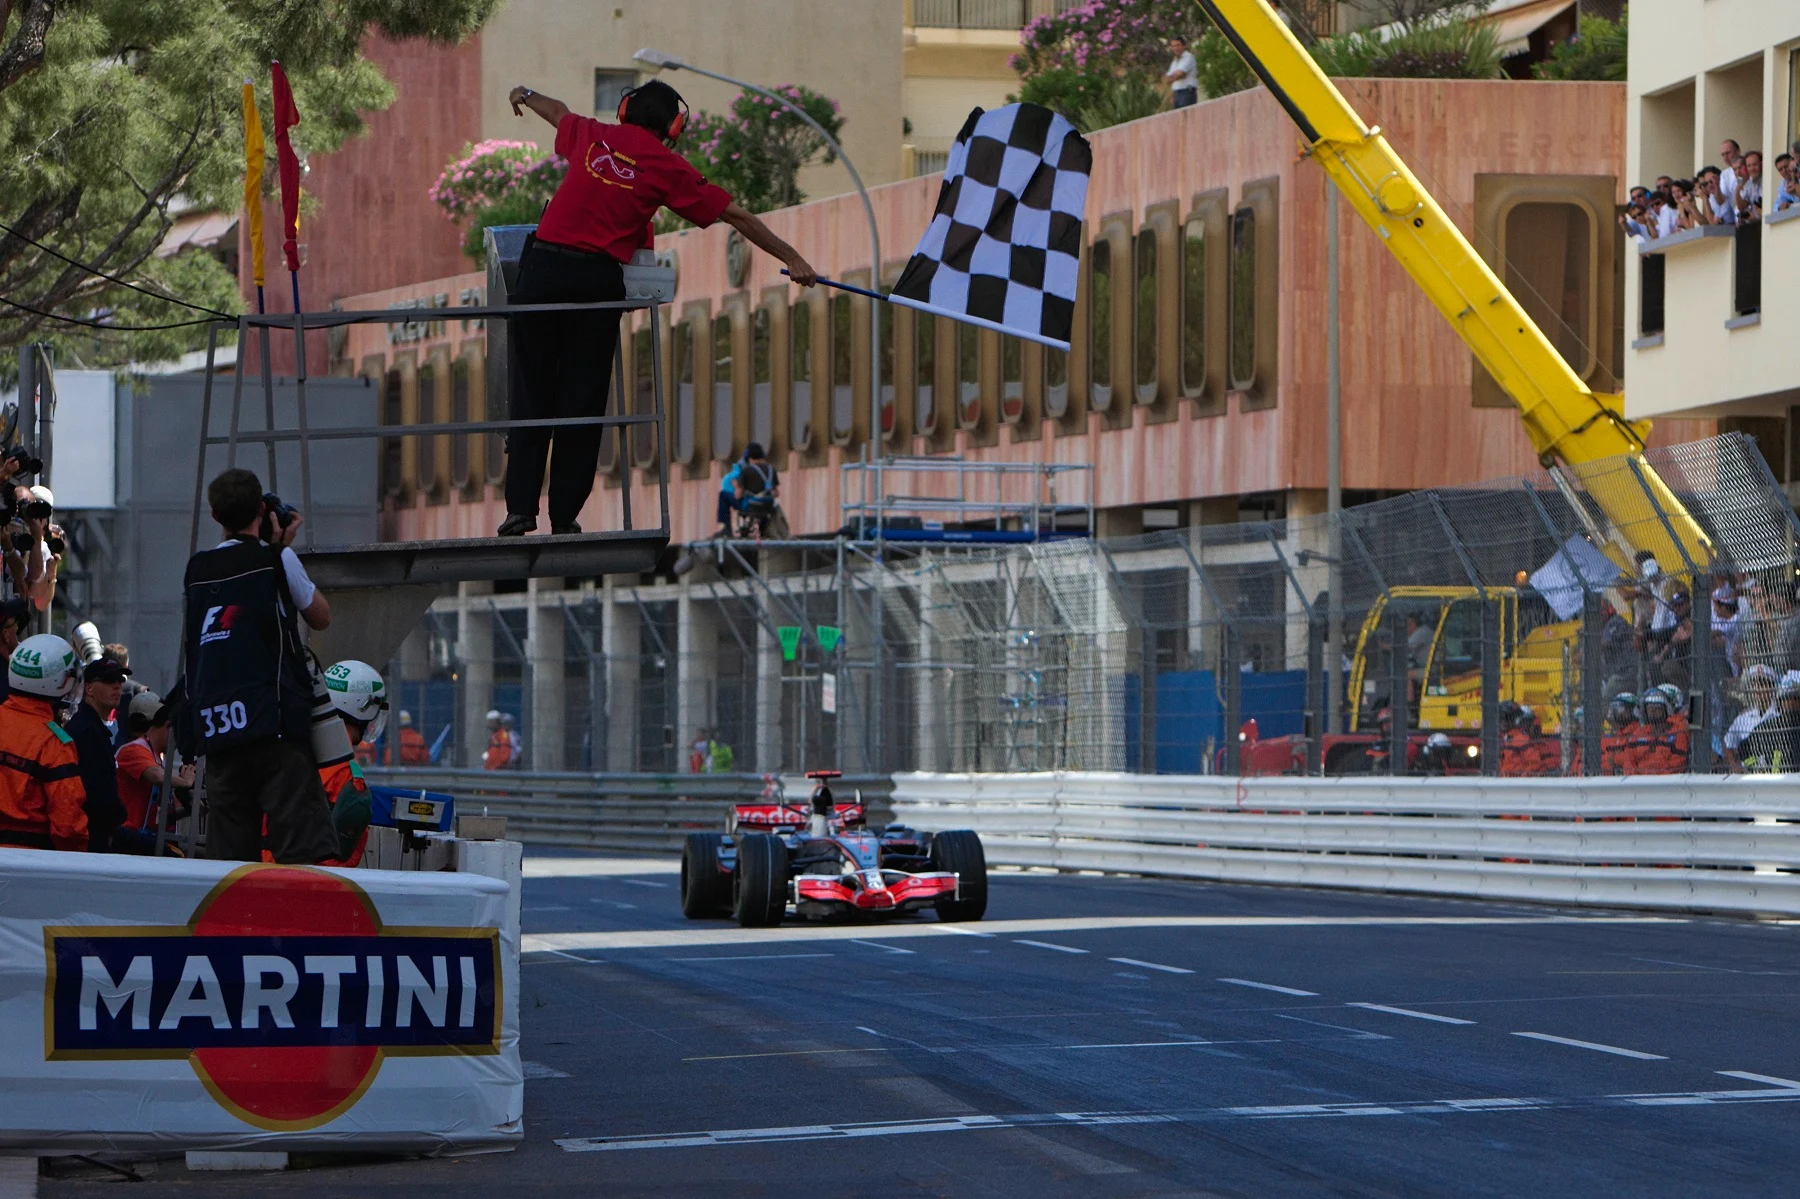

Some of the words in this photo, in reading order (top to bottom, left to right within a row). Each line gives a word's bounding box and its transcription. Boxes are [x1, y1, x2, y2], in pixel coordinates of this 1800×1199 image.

[16, 648, 41, 665] 444
[326, 664, 351, 679] 353
[200, 701, 247, 737] 330
[736, 804, 859, 824] vodafe
[79, 954, 477, 1030] MARTINI
